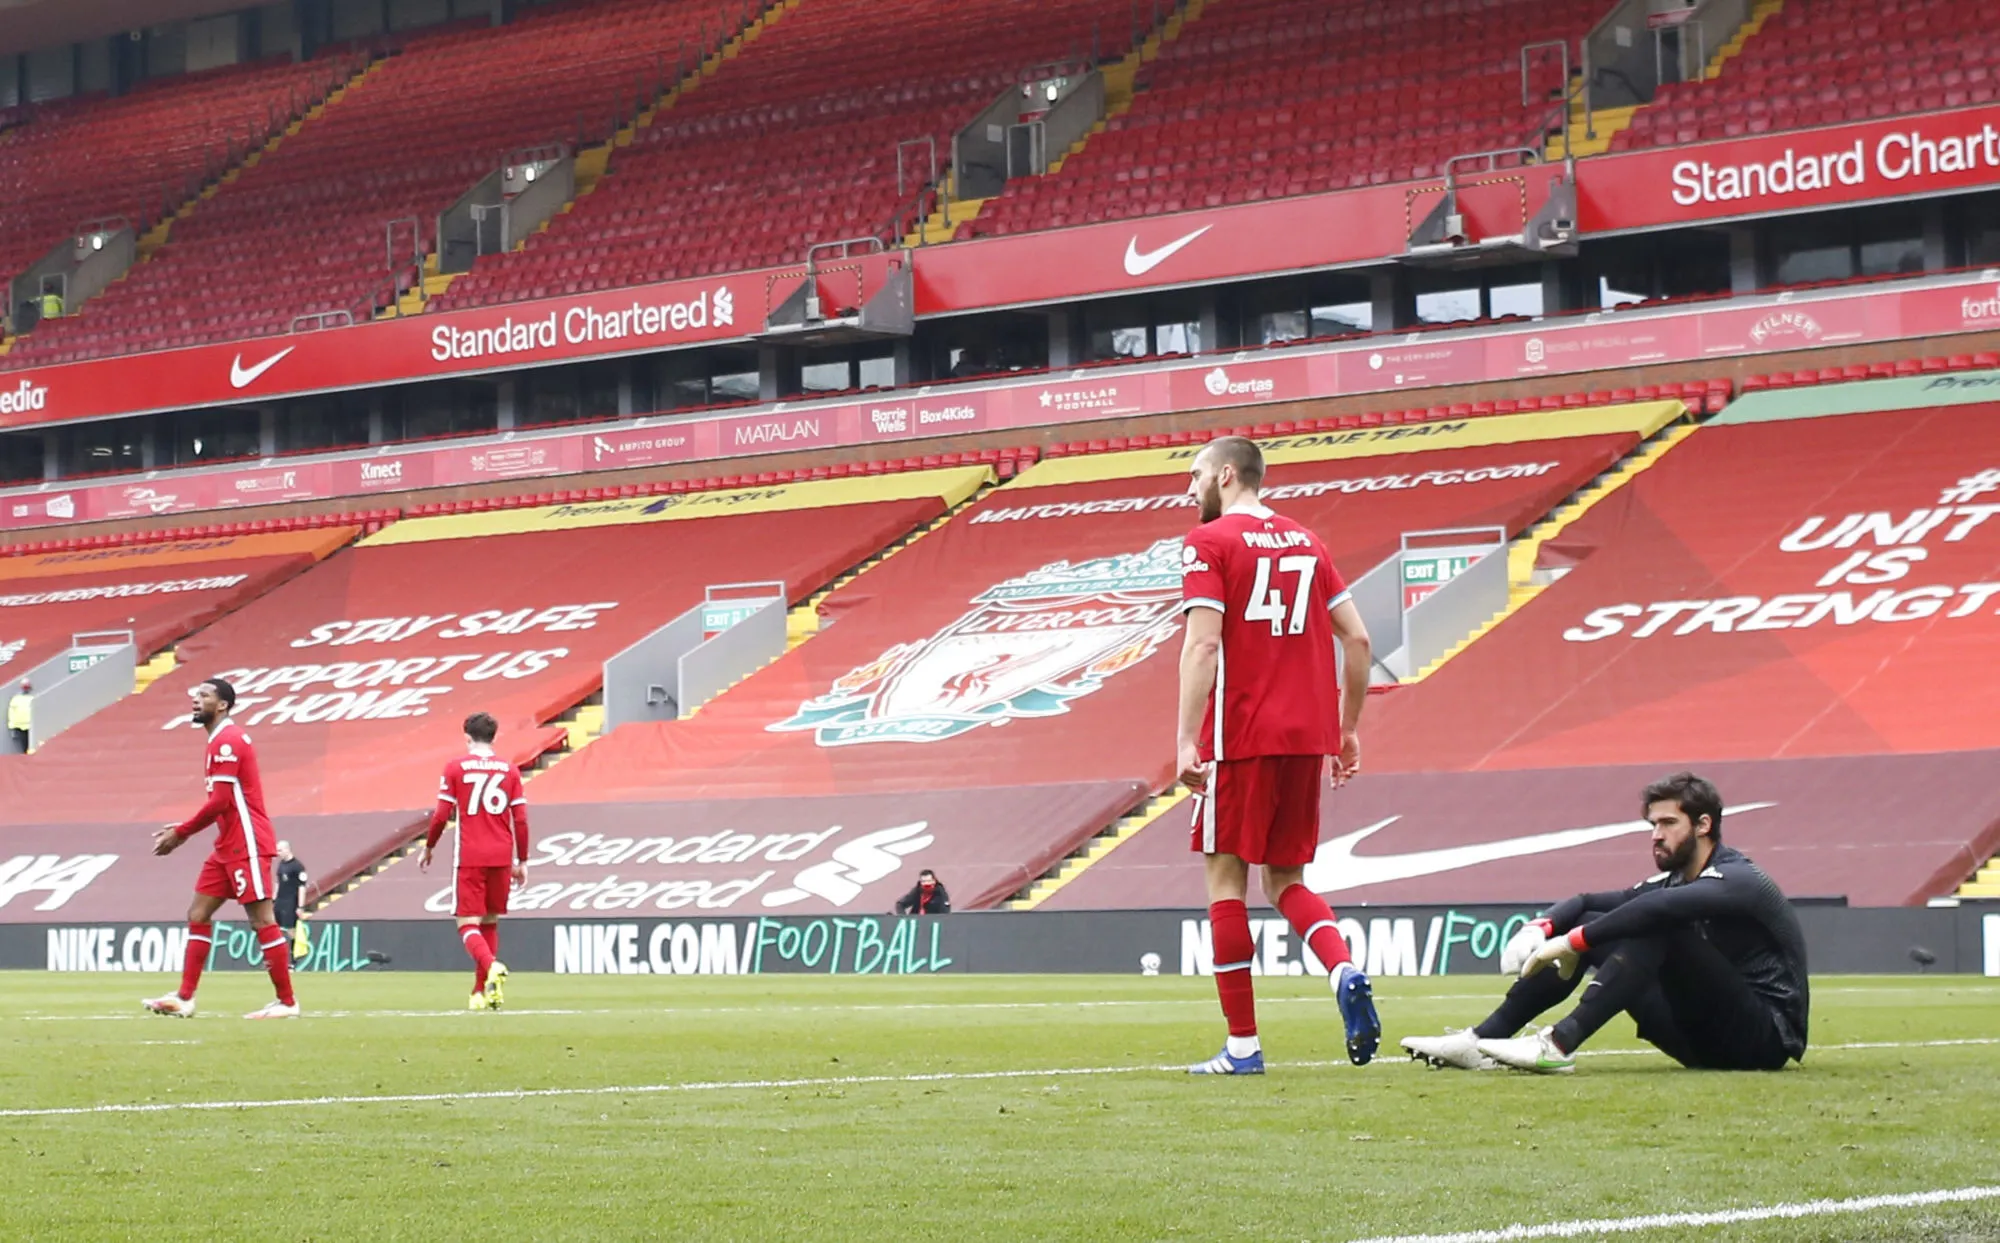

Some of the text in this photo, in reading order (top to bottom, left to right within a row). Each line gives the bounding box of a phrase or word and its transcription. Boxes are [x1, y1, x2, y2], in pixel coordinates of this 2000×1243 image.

[1671, 124, 2000, 206] Standard Chart
[1962, 296, 2000, 318] fort
[431, 291, 707, 362] Standard Chartered
[1751, 312, 1818, 342] KILNER
[1054, 388, 1117, 403] STELLAR
[1228, 379, 1273, 395] certas
[871, 407, 907, 422] Barrie
[920, 405, 975, 424] Box4Kids
[1056, 399, 1115, 410] FOOTBALL
[734, 419, 820, 445] MATALAN
[875, 420, 906, 433] Wells
[1290, 432, 1362, 449] ONE
[1368, 422, 1468, 441] TEAM
[655, 437, 685, 448] GROUP
[361, 460, 402, 480] Kinect
[1242, 531, 1311, 548] PHILLIPS
[1779, 503, 2000, 552] UNIT
[1406, 563, 1434, 579] EXIT
[1815, 547, 1928, 587] IS
[1244, 555, 1318, 636] 47
[290, 602, 619, 648] STAY SAFE.
[705, 612, 730, 627] EXIT
[963, 602, 1167, 632] LIVERPOOL
[1563, 583, 2000, 641] STRENGT
[188, 647, 569, 697] SUPPORT US
[246, 686, 453, 726] HOME.
[460, 760, 509, 772] WILLIAMS
[463, 772, 508, 816] 76
[514, 825, 843, 867] Standard
[234, 868, 247, 891] 5
[424, 869, 776, 912] artered
